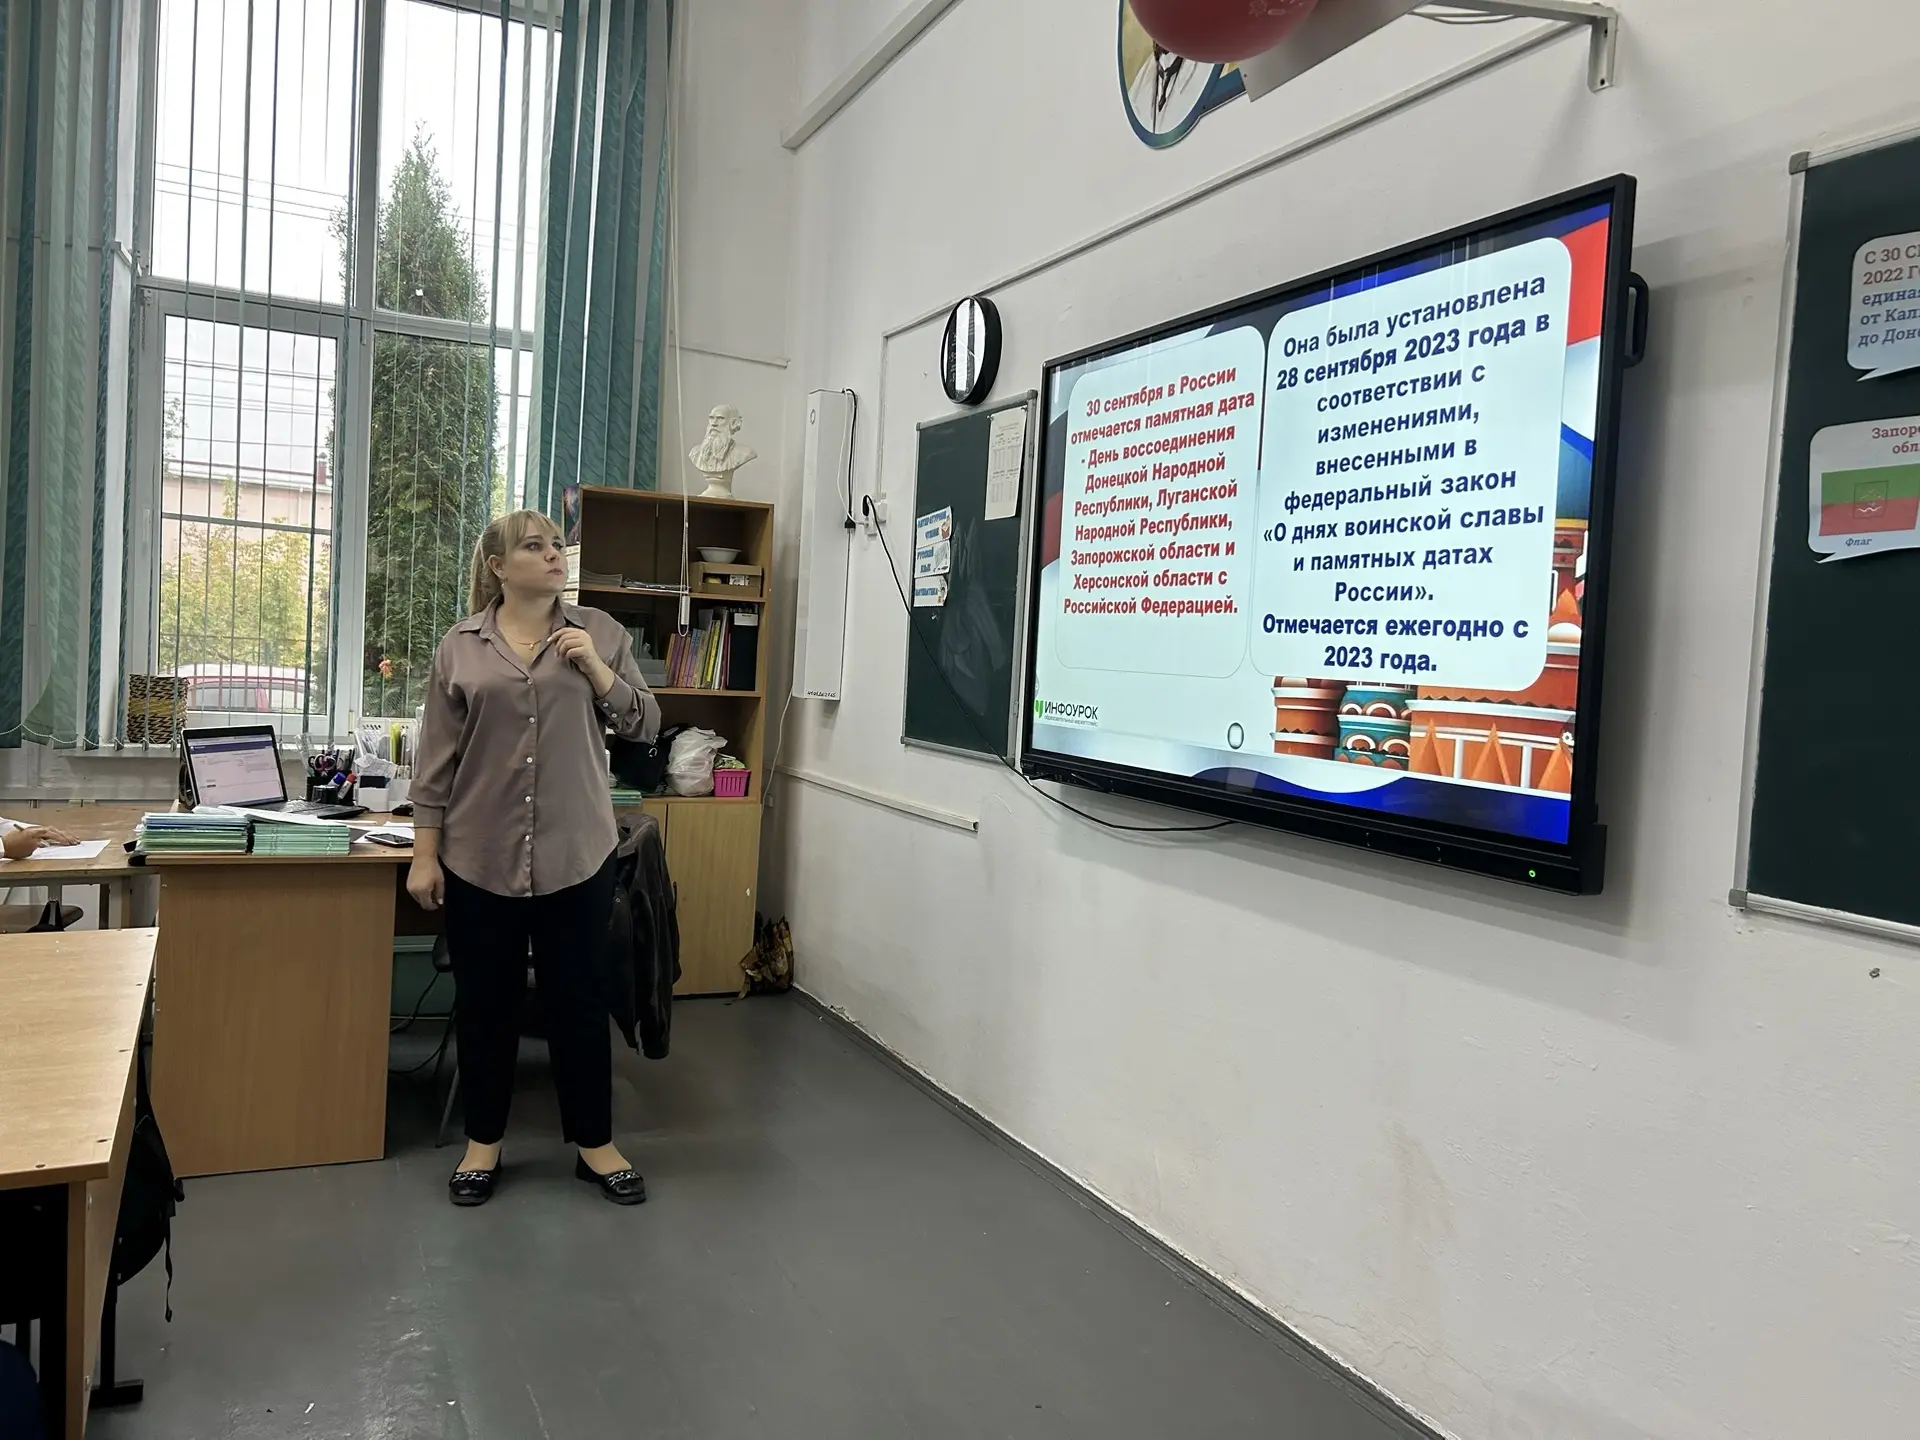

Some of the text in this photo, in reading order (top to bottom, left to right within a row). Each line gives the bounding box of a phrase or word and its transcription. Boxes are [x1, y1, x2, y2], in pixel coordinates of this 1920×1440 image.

[1865, 251, 1876, 264] С
[1881, 247, 1900, 262] 30
[1863, 265, 1920, 285] 2022 Г
[1284, 277, 1545, 357] Она была установлена
[1861, 314, 1880, 325] от
[1277, 313, 1550, 390] 28 сентября 2023 года в
[1858, 334, 1878, 348] до
[1087, 368, 1236, 417] 30 сентября в России
[1317, 365, 1485, 412] соответствии с
[1071, 392, 1254, 445] отмечается памятная дата
[1318, 403, 1479, 443] изменениями,
[1088, 449, 1118, 469] День
[1123, 426, 1235, 459] воссоединения
[1316, 439, 1477, 475] внесенными в
[1085, 452, 1225, 494] Донецкой Народной
[1075, 480, 1237, 517] Республики, Луганской
[1285, 471, 1516, 514] федеральный закон
[1076, 513, 1232, 543] Народной Республики,
[1264, 505, 1543, 543] «О днях воинской славы
[1071, 540, 1235, 567] Запорожской области и
[1846, 538, 1872, 546] Флаг
[1294, 546, 1493, 571] и памятных датах
[1073, 568, 1227, 593] Херсонской области с
[1335, 581, 1434, 602] России».
[1064, 595, 1237, 617] Российской Федерацией.
[1263, 614, 1528, 641] Отмечается ежегодно с
[1324, 646, 1437, 674] 2023 года.
[1045, 701, 1098, 720] ИНФОУРОК
